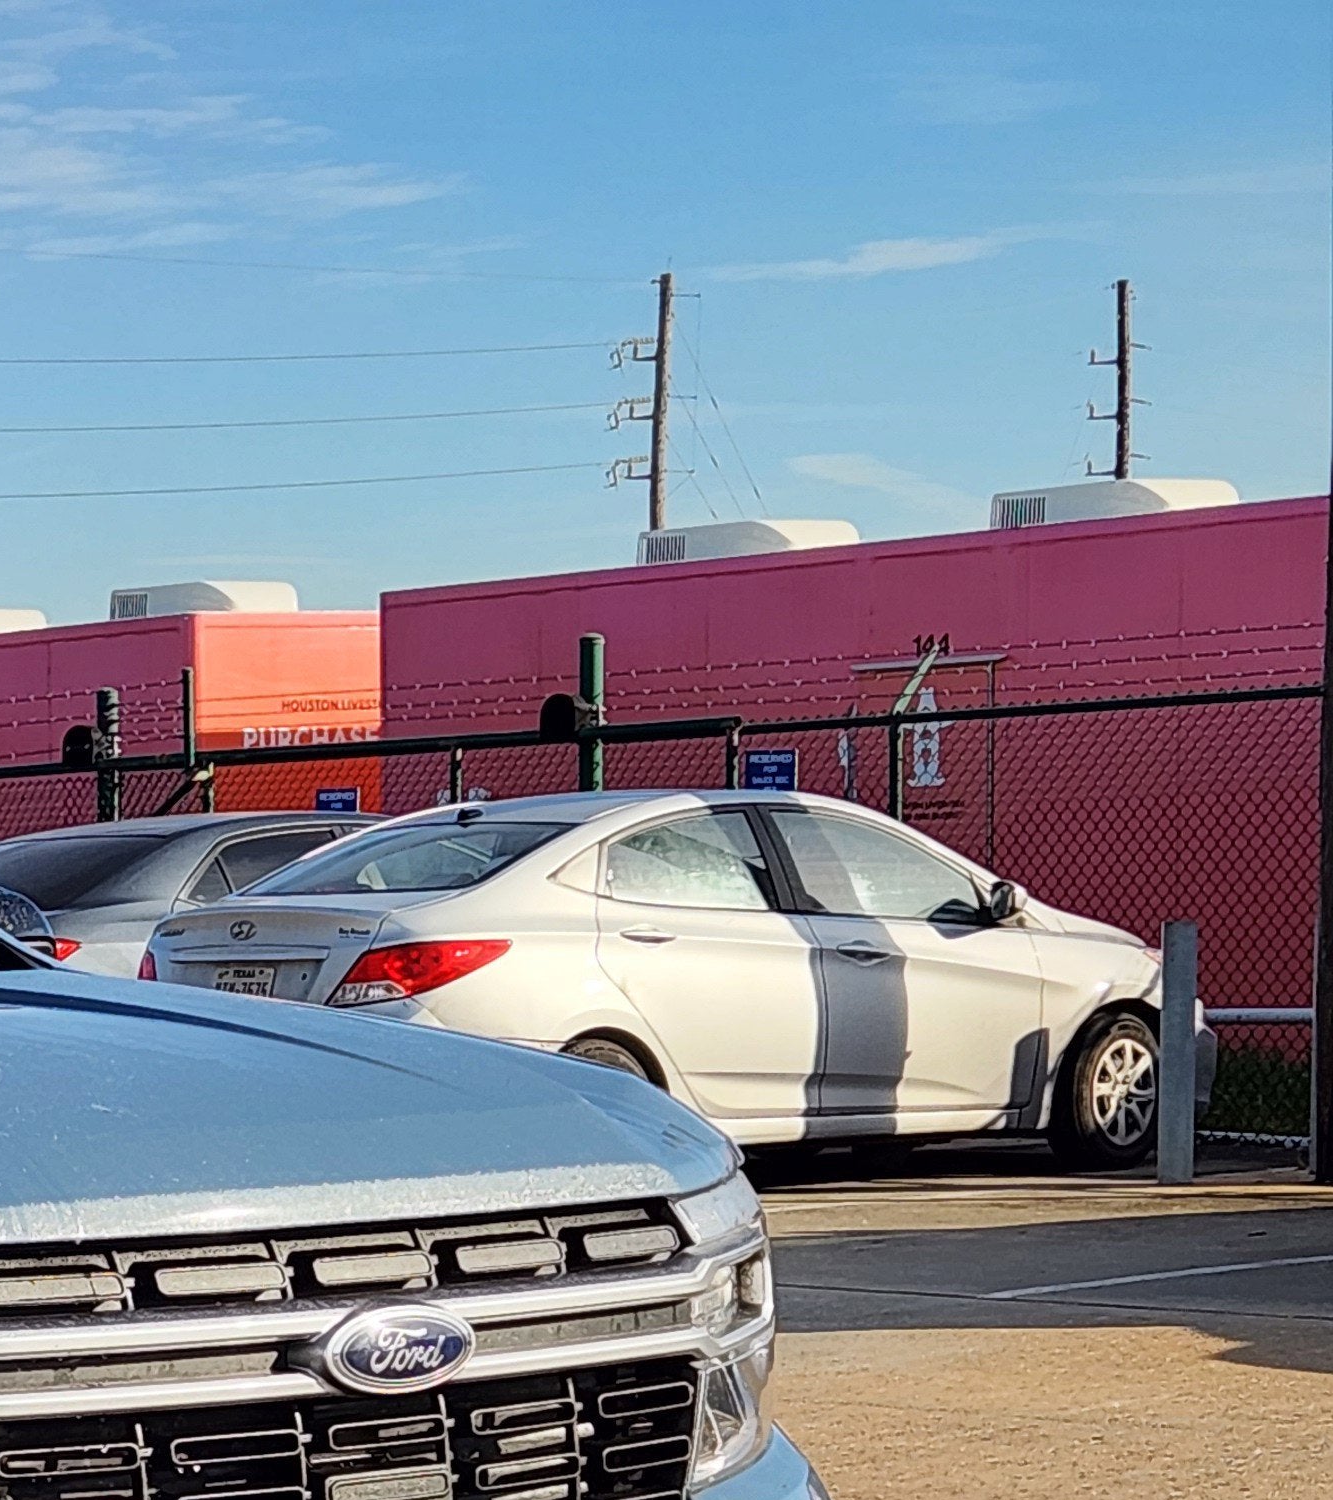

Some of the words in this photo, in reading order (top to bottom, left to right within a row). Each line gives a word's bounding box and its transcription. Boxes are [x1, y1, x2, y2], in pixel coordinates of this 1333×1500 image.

[282, 699, 340, 713] HOUSTON
[241, 726, 381, 750] PURCHASE
[369, 1326, 446, 1375] Ford
